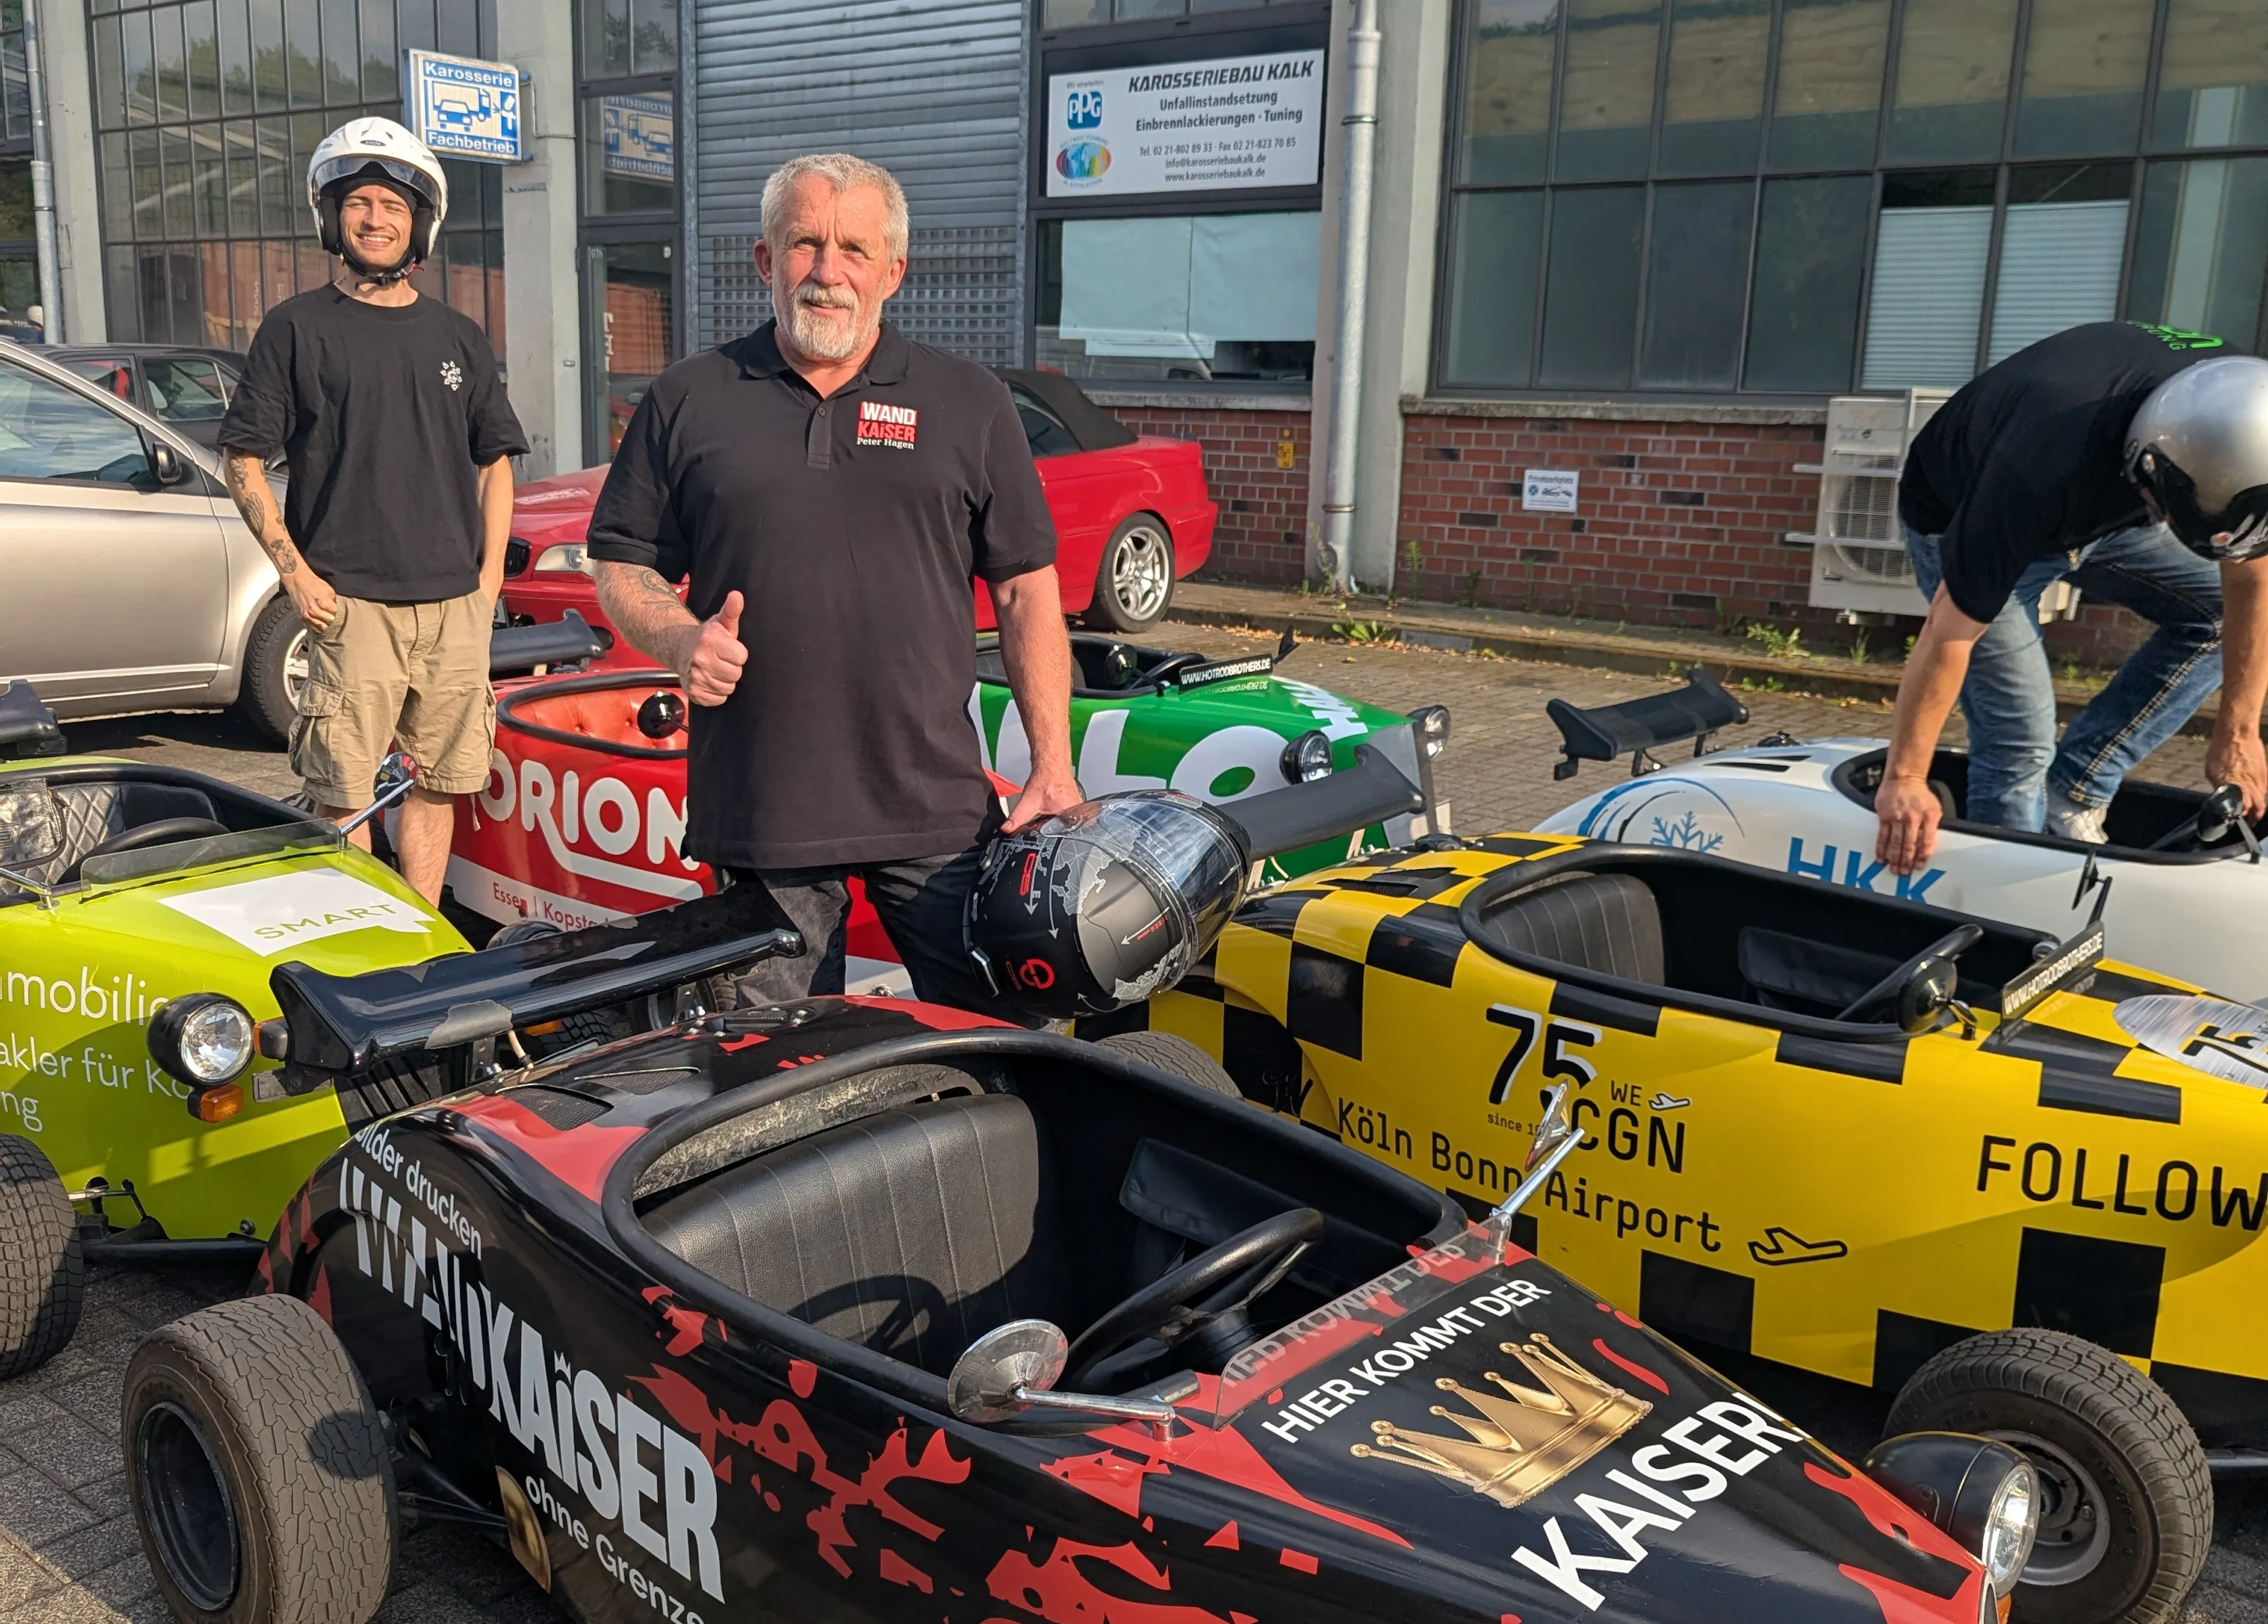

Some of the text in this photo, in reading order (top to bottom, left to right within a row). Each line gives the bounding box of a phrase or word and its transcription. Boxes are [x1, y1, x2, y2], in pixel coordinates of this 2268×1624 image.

[425, 63, 513, 87] Karosserie
[1129, 60, 1315, 93] KAROSSERIEBAU KALK
[1069, 92, 1101, 123] PPG
[1160, 92, 1278, 111] Unfallinstandsetzung
[1136, 109, 1303, 132] Einbrennlackierungen Tuning
[428, 132, 515, 154] Fachbetrieb
[1139, 146, 1151, 156] Tel.
[1153, 146, 1162, 155] 02
[1165, 145, 1190, 155] 21-802
[1203, 144, 1213, 153] 33
[1219, 142, 1231, 151] Fax
[1233, 141, 1243, 151] 02
[1245, 139, 1272, 150] 21-823
[1275, 138, 1284, 148] 70
[1286, 137, 1297, 147] 85
[1165, 153, 1266, 169] info@karosseriebaukalk.de
[1165, 168, 1265, 182] www.karosseriebaukalk.de
[862, 401, 915, 425] WAND
[856, 437, 914, 449] Peter Hagen
[1181, 658, 1272, 685] WWW.HOTRODBROTHERS.DE
[1788, 837, 1946, 903] HKK
[255, 903, 398, 940] SMART
[2005, 931, 2103, 1015] WWW.HOTRODBROTHERS.DE
[82, 1046, 135, 1090] für
[1486, 1003, 1602, 1114] 75
[1611, 1080, 1641, 1107] WE
[0, 1091, 43, 1132] ng
[1487, 1113, 1522, 1132] since
[1569, 1097, 1685, 1174] CGN
[1338, 1097, 1721, 1252] Köln Bonn Airport
[1977, 1134, 2268, 1231] FOLLOW
[406, 1159, 482, 1261] drucken
[1262, 1279, 1552, 1443] HIER KOMMT DER
[526, 1475, 589, 1550] ohne
